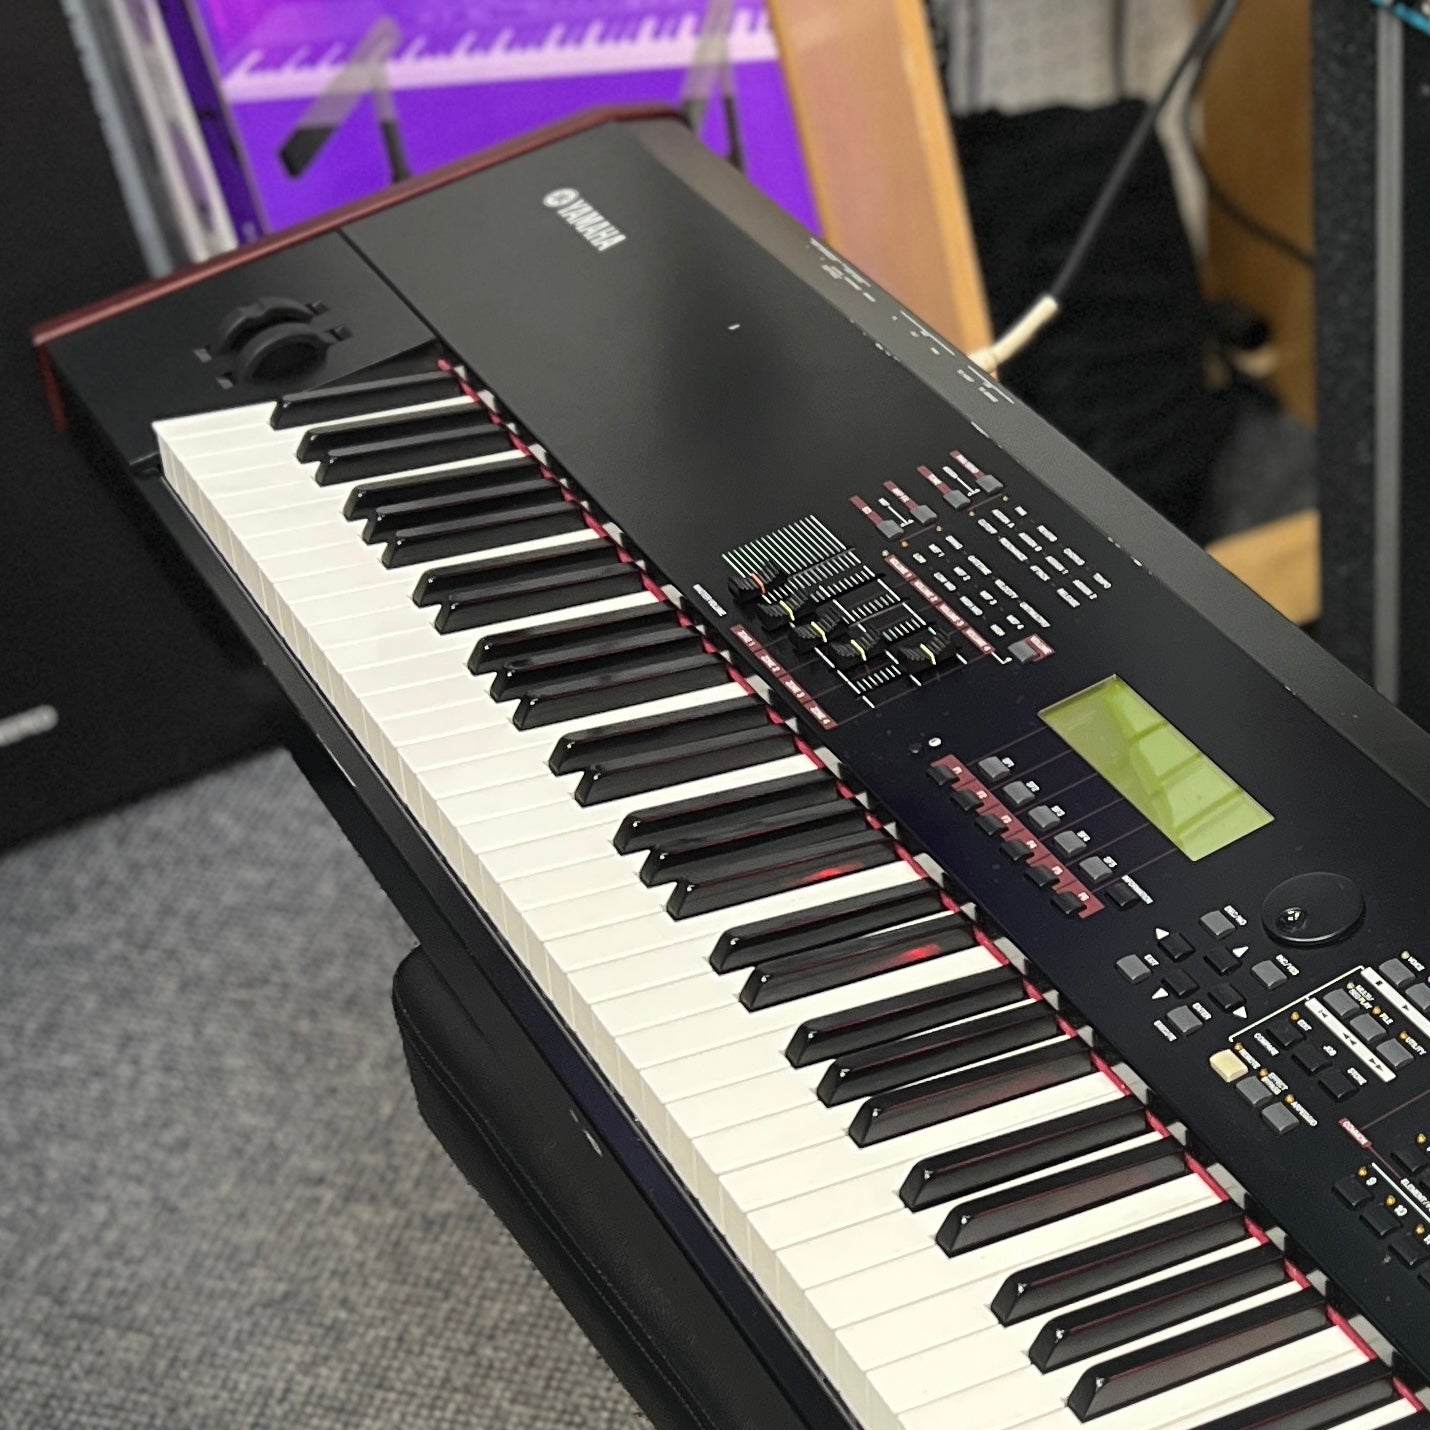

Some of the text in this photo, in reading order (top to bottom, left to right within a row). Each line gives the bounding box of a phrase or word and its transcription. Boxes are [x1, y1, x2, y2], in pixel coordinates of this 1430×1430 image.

[557, 198, 627, 251] YAMAHA
[1407, 956, 1426, 972] VOICE
[1379, 1012, 1394, 1026] FILE
[1323, 1045, 1337, 1057] JOB
[1405, 1036, 1428, 1056] UTILITY
[1365, 1175, 1378, 1187] 9
[1393, 1204, 1408, 1217] 10
